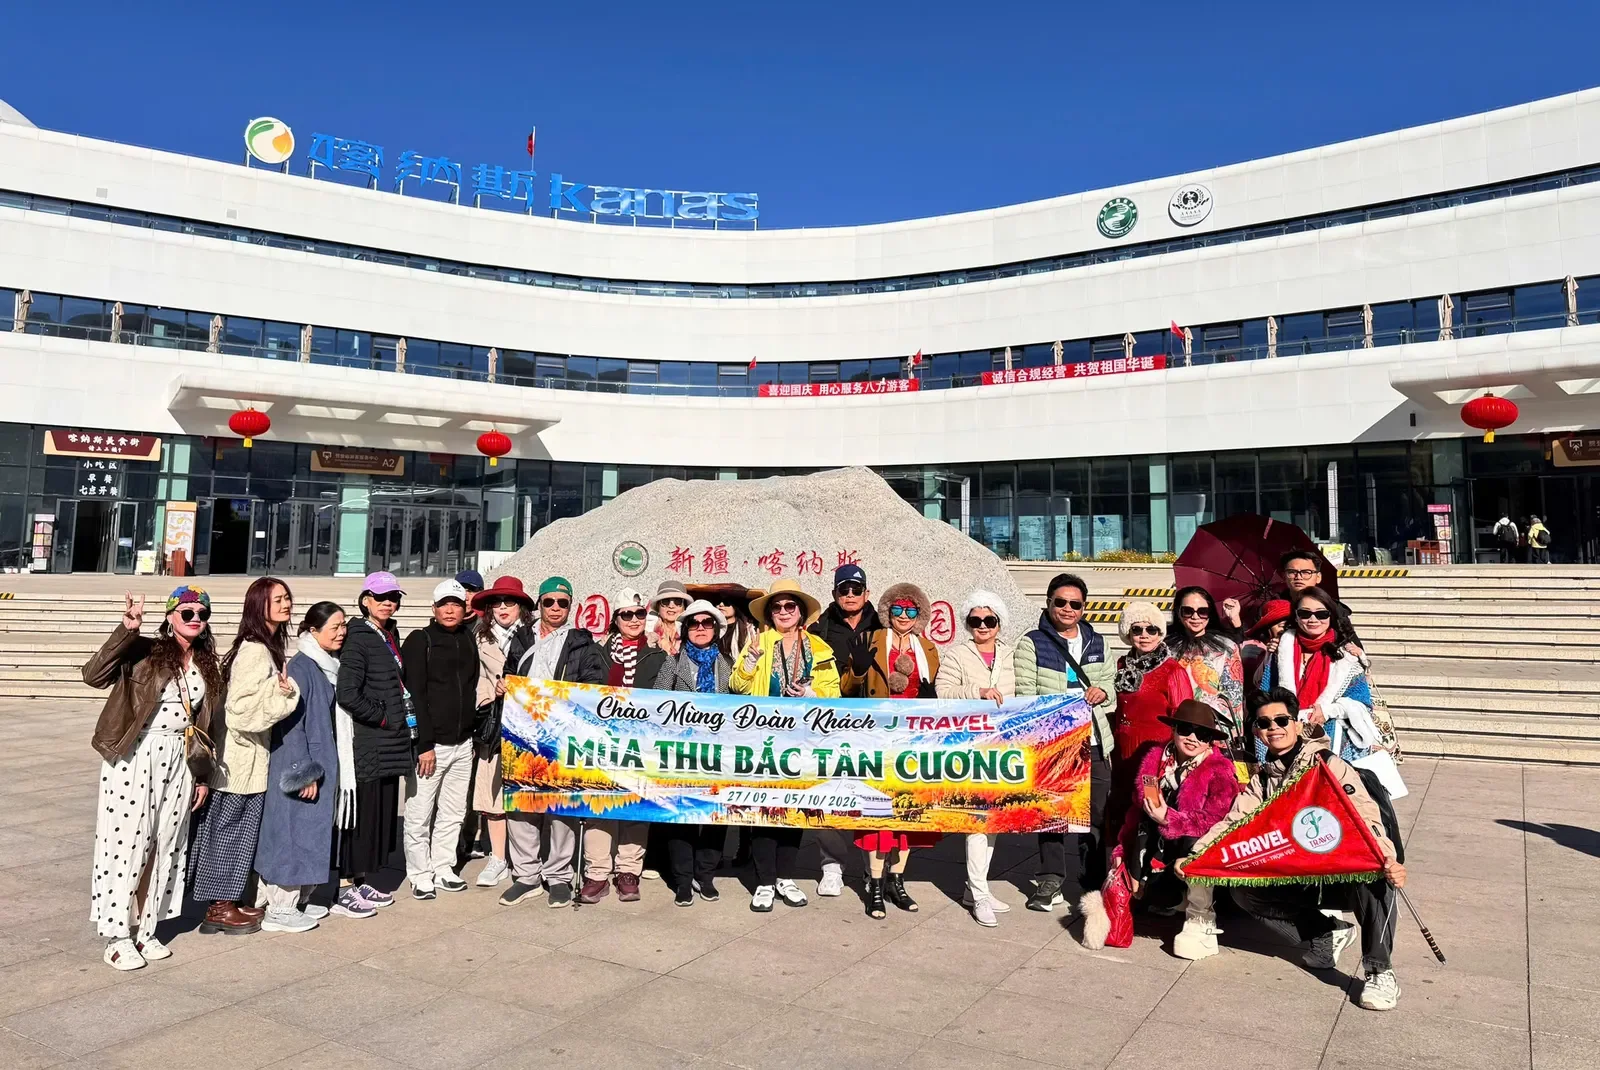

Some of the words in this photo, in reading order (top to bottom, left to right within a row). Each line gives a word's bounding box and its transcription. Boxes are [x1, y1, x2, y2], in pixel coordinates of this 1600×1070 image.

[308, 132, 537, 209] 喀纳斯
[550, 173, 760, 221] kanas
[992, 365, 1067, 384] 诚信合规经营
[1074, 356, 1154, 376] 共贺祖国华诞
[768, 384, 813, 396] 喜迎国庆
[818, 379, 910, 395] 用心服务八方游客
[382, 458, 395, 468] A2
[596, 696, 650, 721] Chào
[656, 699, 726, 731] Mừng
[732, 704, 796, 730] Đoàn
[803, 707, 876, 734] Khách
[885, 716, 898, 730] J
[906, 714, 995, 731] TRAVEL
[566, 731, 644, 769] MÙA
[653, 739, 722, 774] THU
[734, 736, 801, 779] BẮC
[812, 743, 884, 779] TÂN
[896, 750, 1026, 782] CƯƠNG
[727, 791, 767, 803] 27/09
[784, 793, 857, 808] 05/10/2026
[1220, 847, 1229, 863] J
[1230, 829, 1289, 858] TRAVEL
